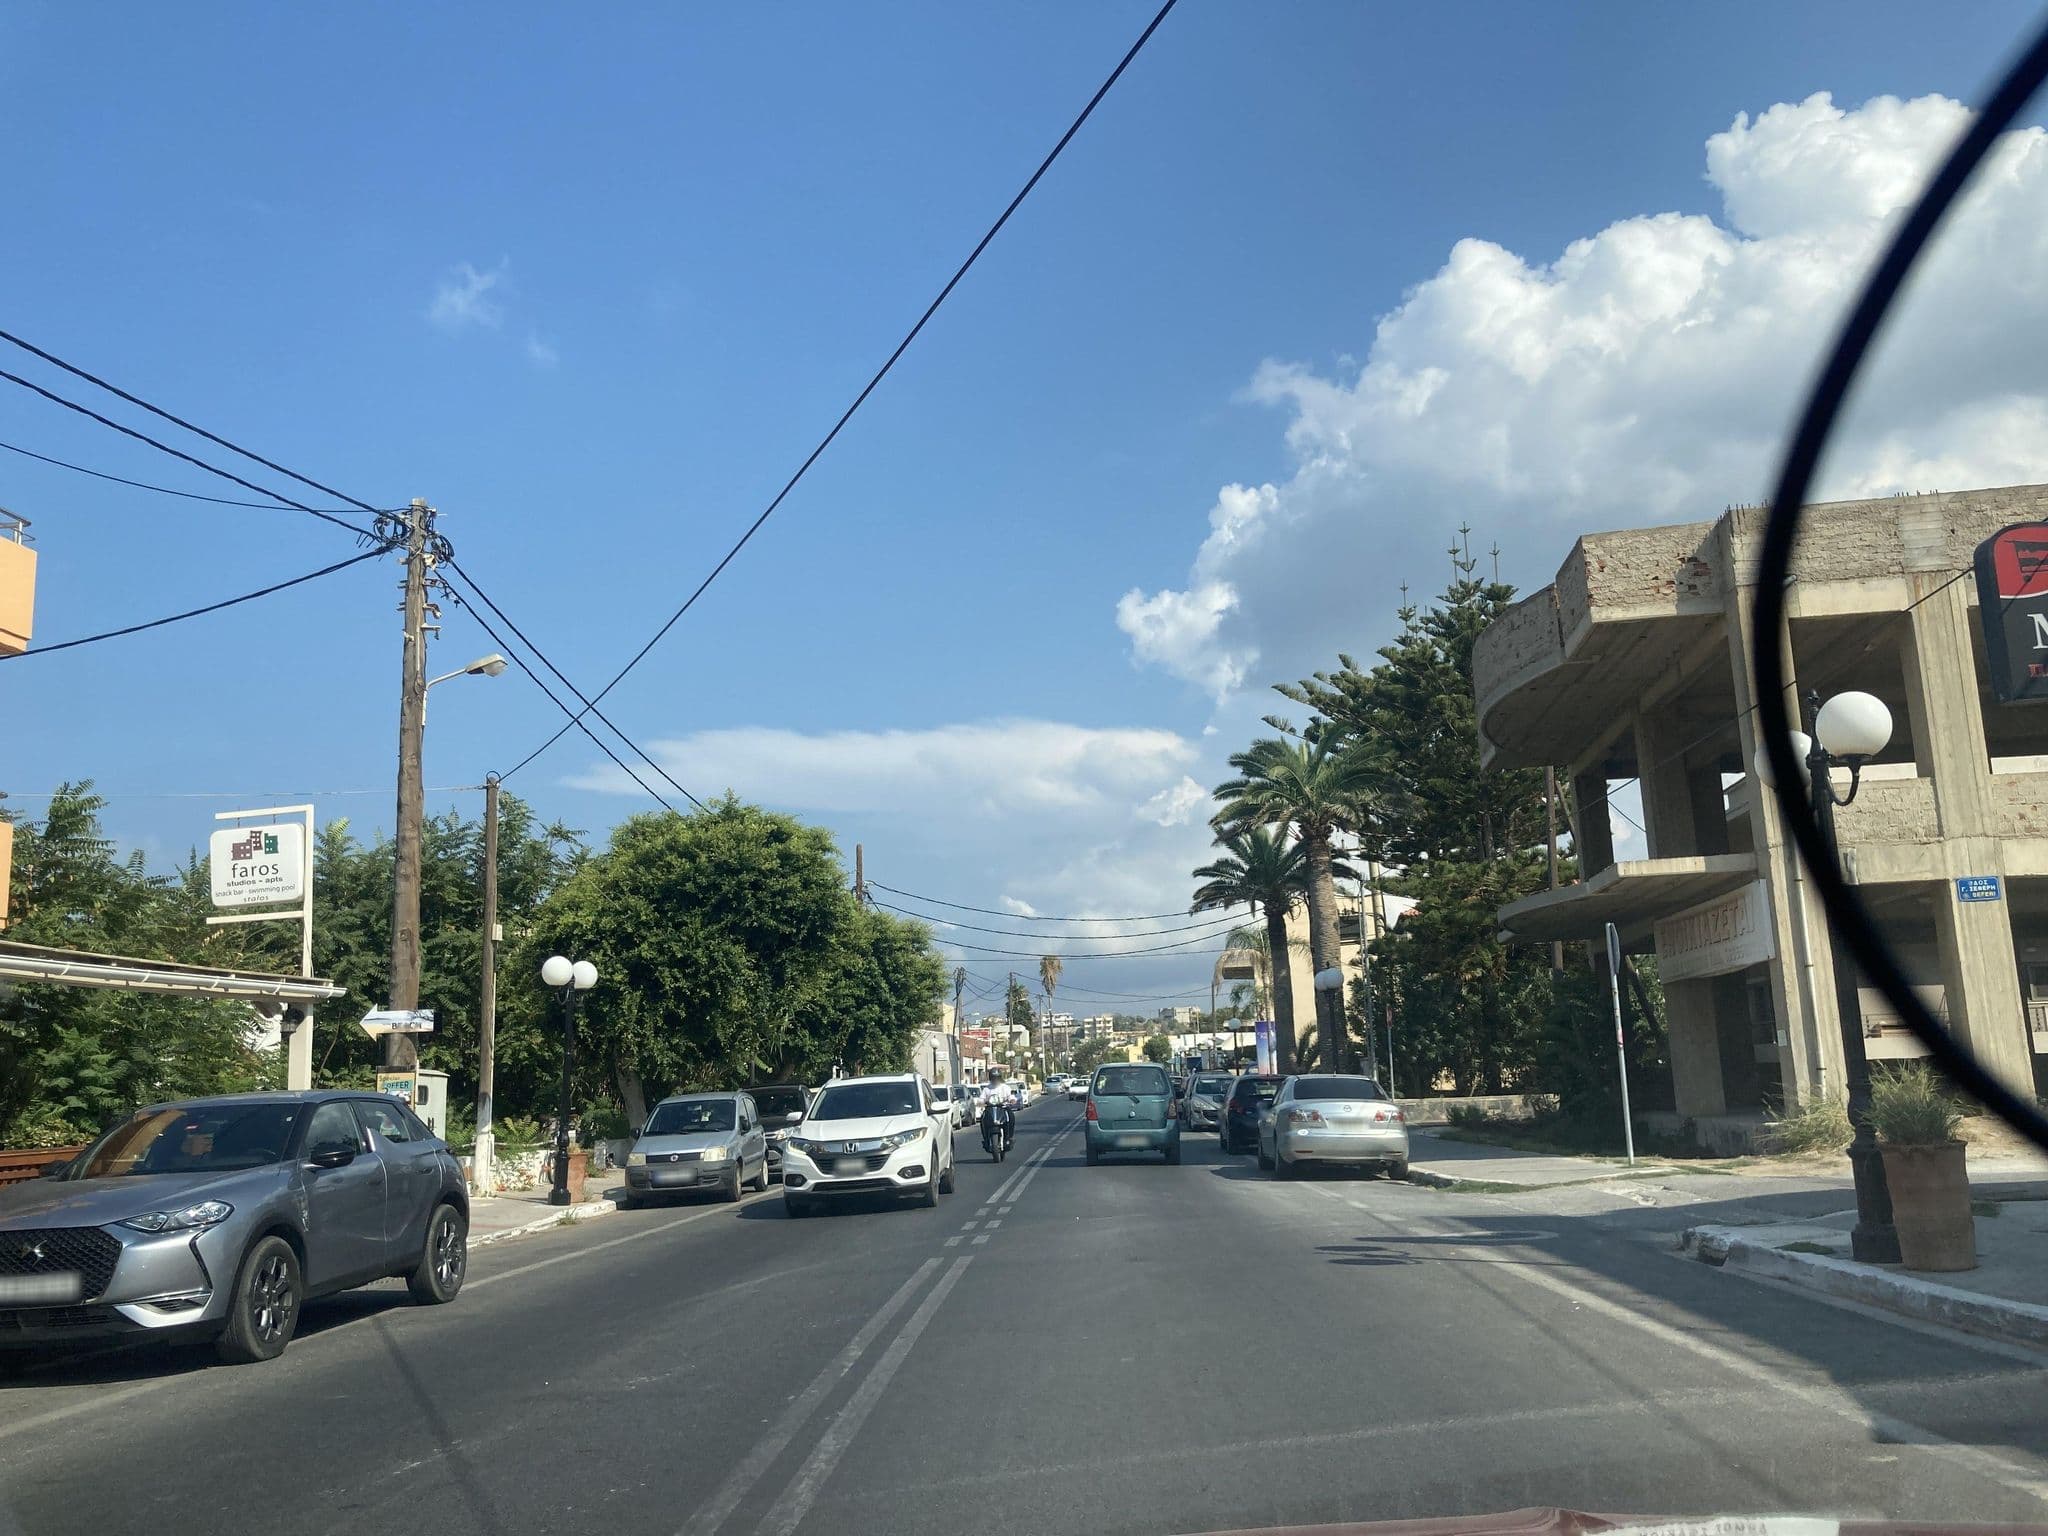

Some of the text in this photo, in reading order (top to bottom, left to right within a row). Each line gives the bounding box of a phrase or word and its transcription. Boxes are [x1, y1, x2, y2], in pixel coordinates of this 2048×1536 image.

[231, 863, 279, 878] faros
[265, 876, 283, 884] apts
[248, 885, 280, 894] swimming
[281, 884, 296, 892] pool
[386, 1081, 410, 1089] OFFER
